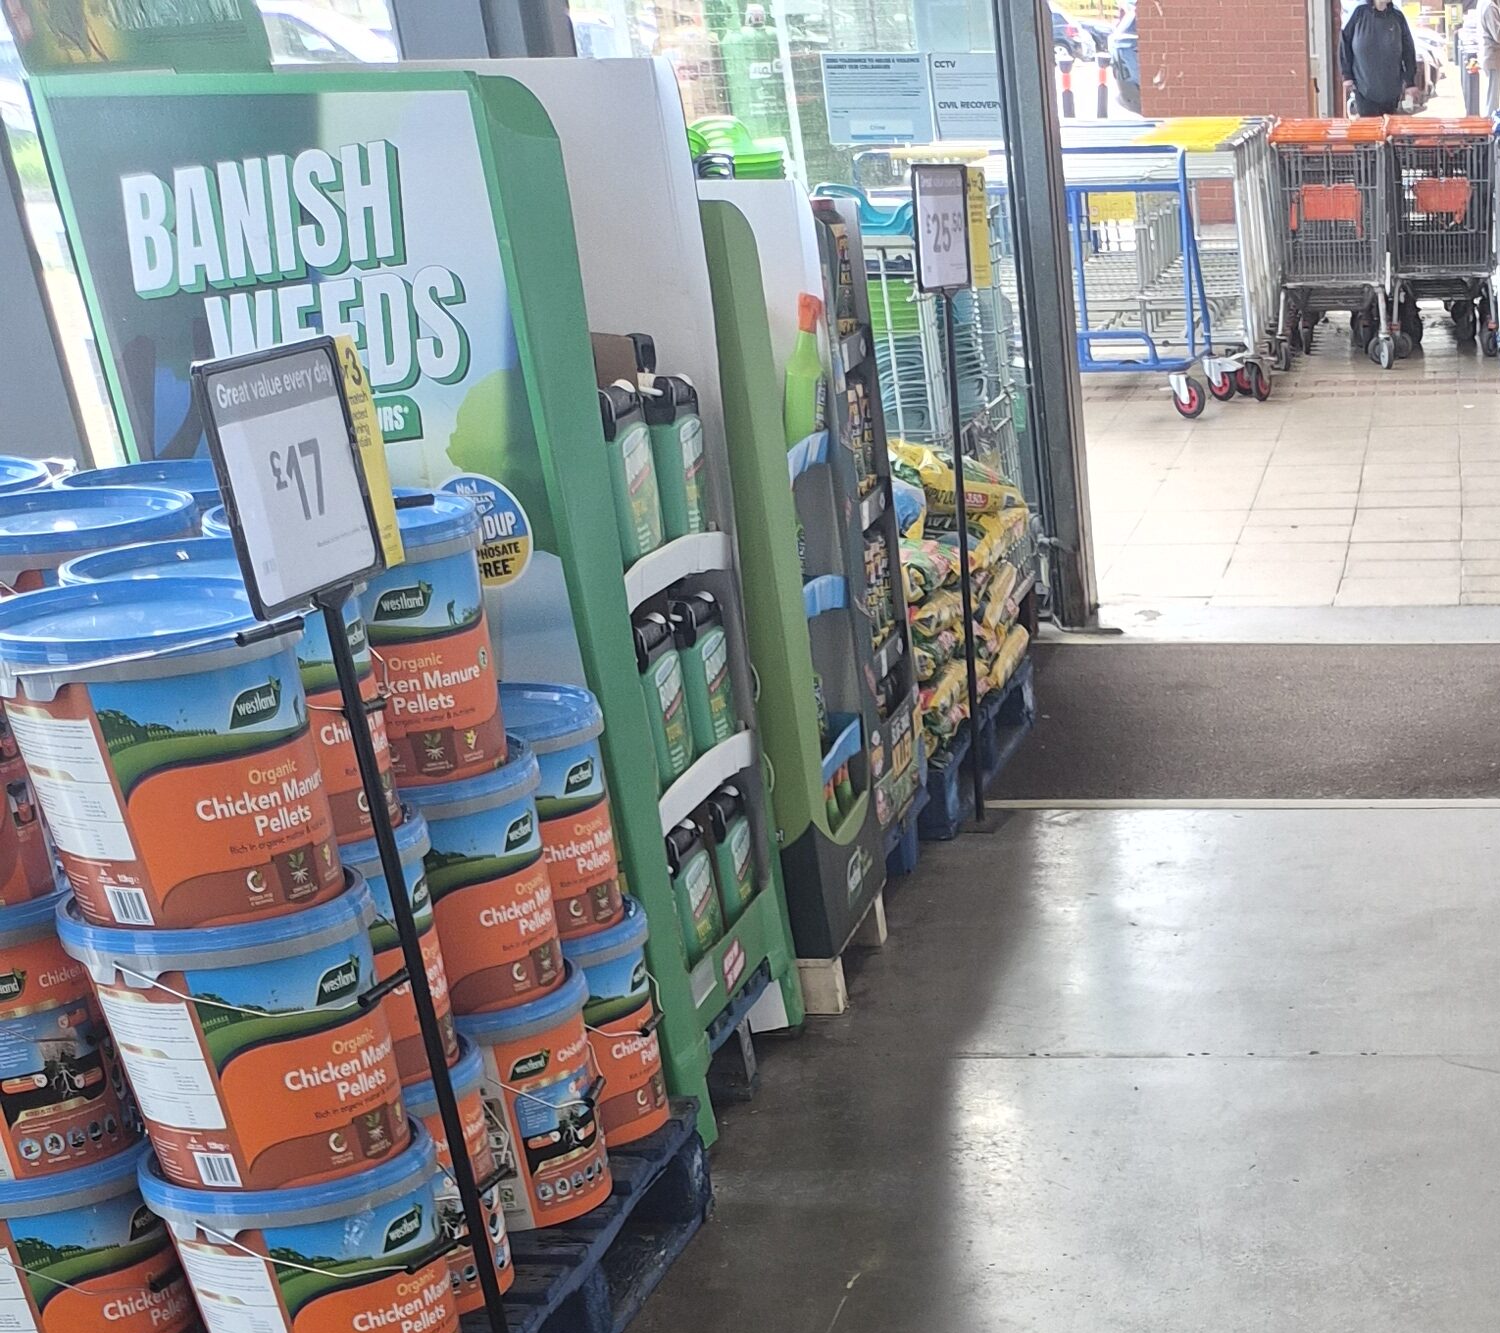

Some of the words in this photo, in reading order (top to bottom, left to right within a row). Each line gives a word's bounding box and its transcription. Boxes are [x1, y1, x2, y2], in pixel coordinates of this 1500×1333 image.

[934, 60, 956, 69] CCTV
[938, 101, 958, 110] CIVIL
[119, 139, 405, 298] BANISH
[216, 380, 251, 409] Great
[251, 374, 283, 401] value
[283, 369, 314, 397] every
[313, 361, 334, 387] day
[269, 437, 326, 521] £17
[381, 590, 425, 612] westland
[388, 652, 443, 674] Organic
[423, 664, 480, 690] Manure
[236, 688, 276, 717] westland
[393, 692, 455, 716] Pellets
[248, 758, 297, 785] Organic
[196, 789, 281, 823] Chicken
[255, 803, 312, 837] Pellets
[543, 836, 594, 864] Chicken
[576, 849, 611, 875] Pellets
[479, 895, 536, 928] Chicken
[321, 969, 357, 994] westland
[332, 1026, 374, 1056] Organic
[284, 1059, 361, 1092] Chicken
[337, 1067, 387, 1102] Pellets
[388, 1213, 420, 1241] westland
[396, 1269, 436, 1296] Organic
[103, 1285, 170, 1321] Chicken
[352, 1297, 424, 1333] Chicken
